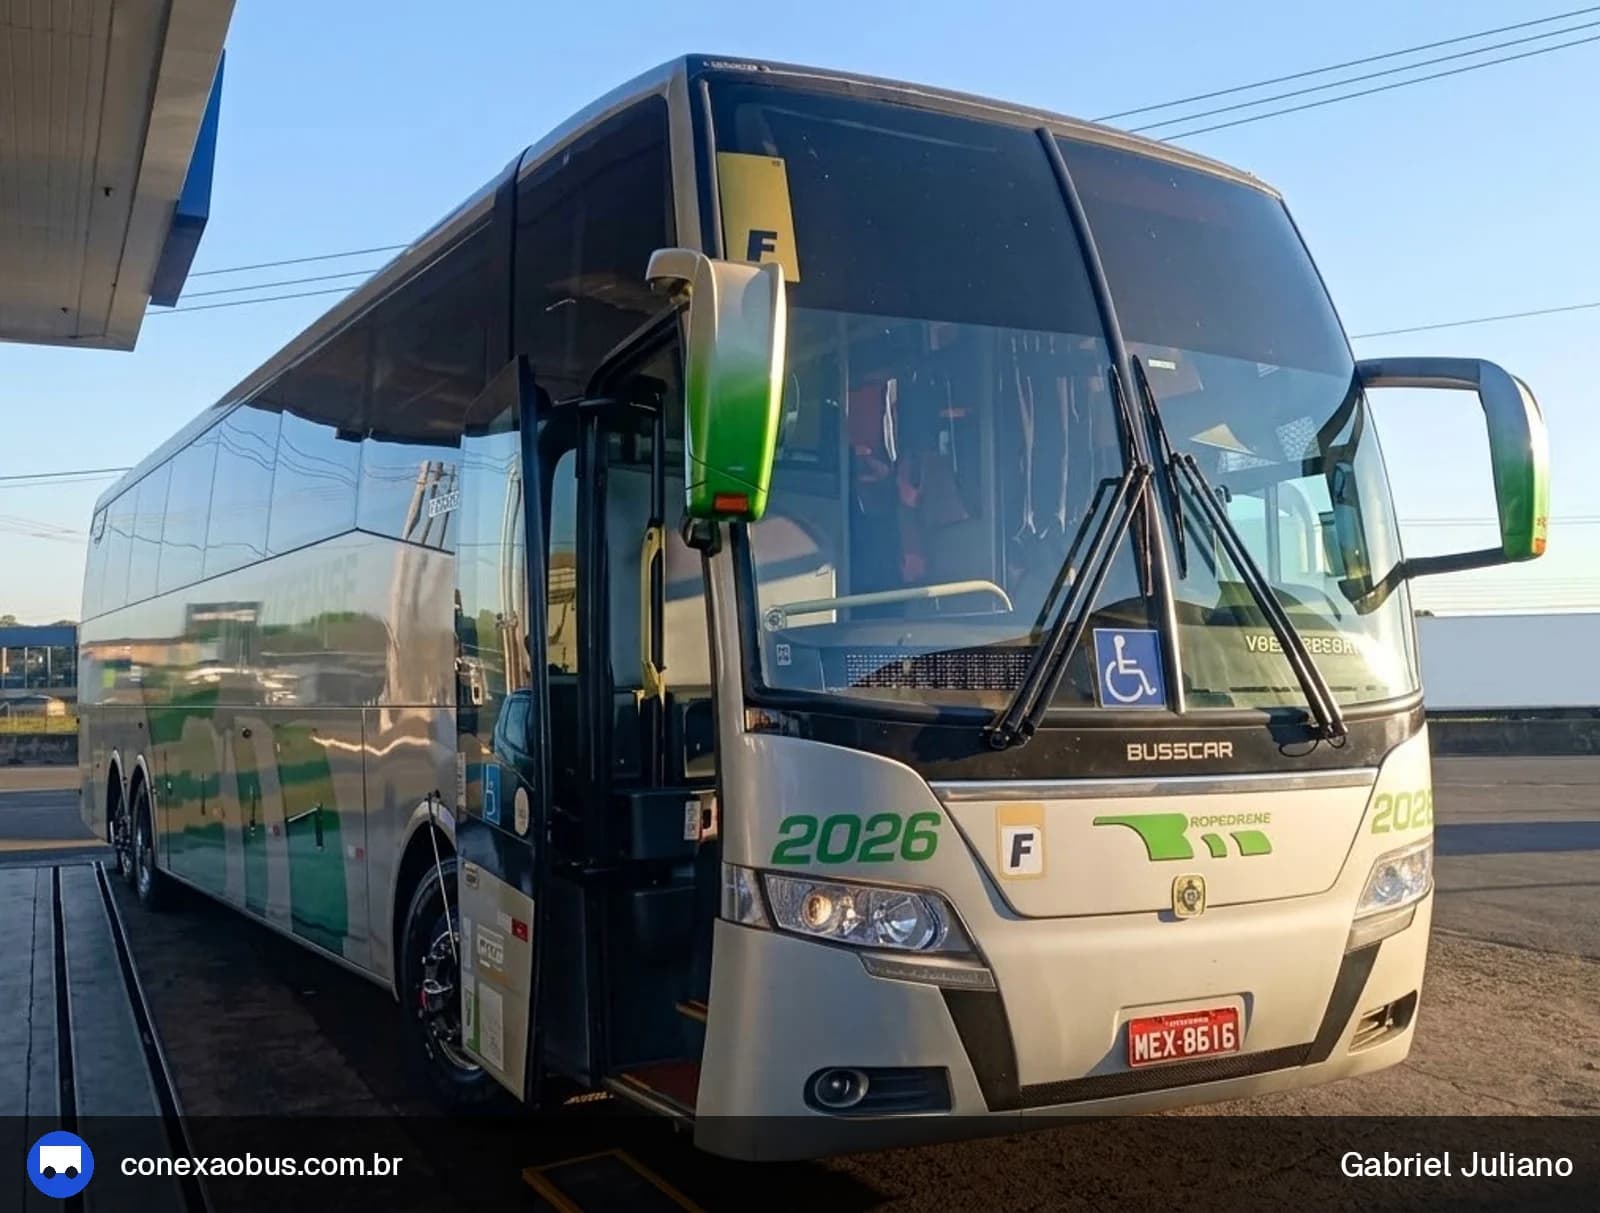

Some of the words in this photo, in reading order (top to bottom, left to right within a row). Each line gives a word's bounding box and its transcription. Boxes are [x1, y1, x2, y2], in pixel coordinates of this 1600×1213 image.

[747, 230, 777, 261] F
[1126, 742, 1233, 761] BUSSCAR
[771, 812, 941, 864] 2026
[1010, 833, 1034, 868] F
[1134, 1022, 1235, 1061] MEX-8616
